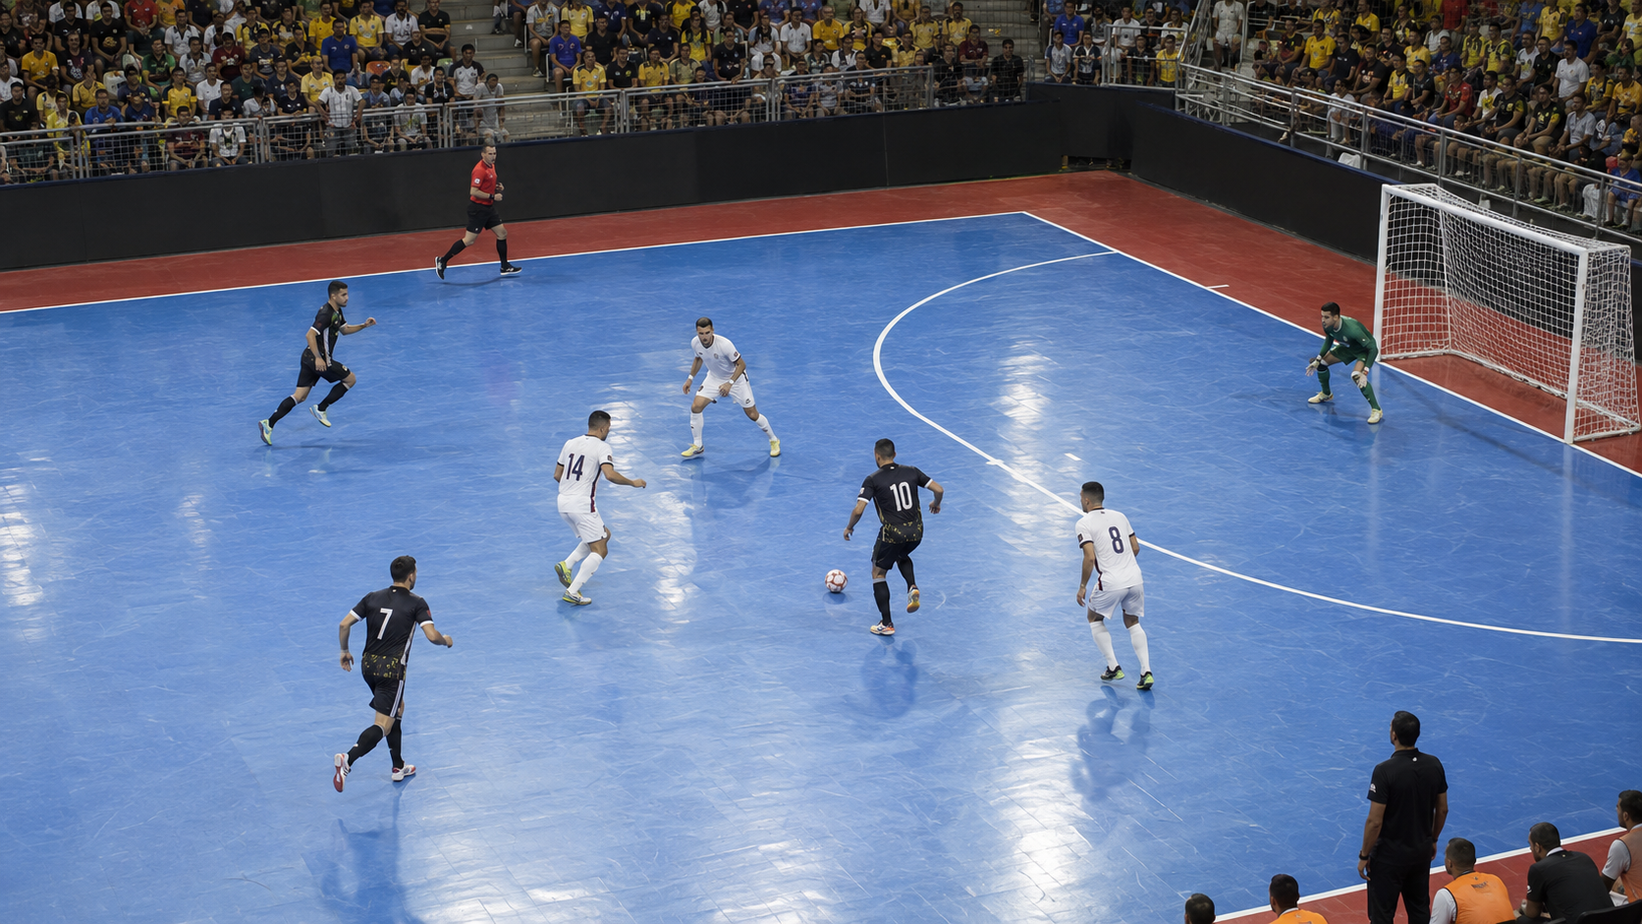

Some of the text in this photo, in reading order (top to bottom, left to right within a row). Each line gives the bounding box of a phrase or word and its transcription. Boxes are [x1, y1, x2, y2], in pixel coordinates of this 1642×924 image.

[566, 453, 585, 481] 14
[890, 481, 913, 511] 10
[1109, 526, 1124, 554] 8
[377, 608, 393, 640] 7
